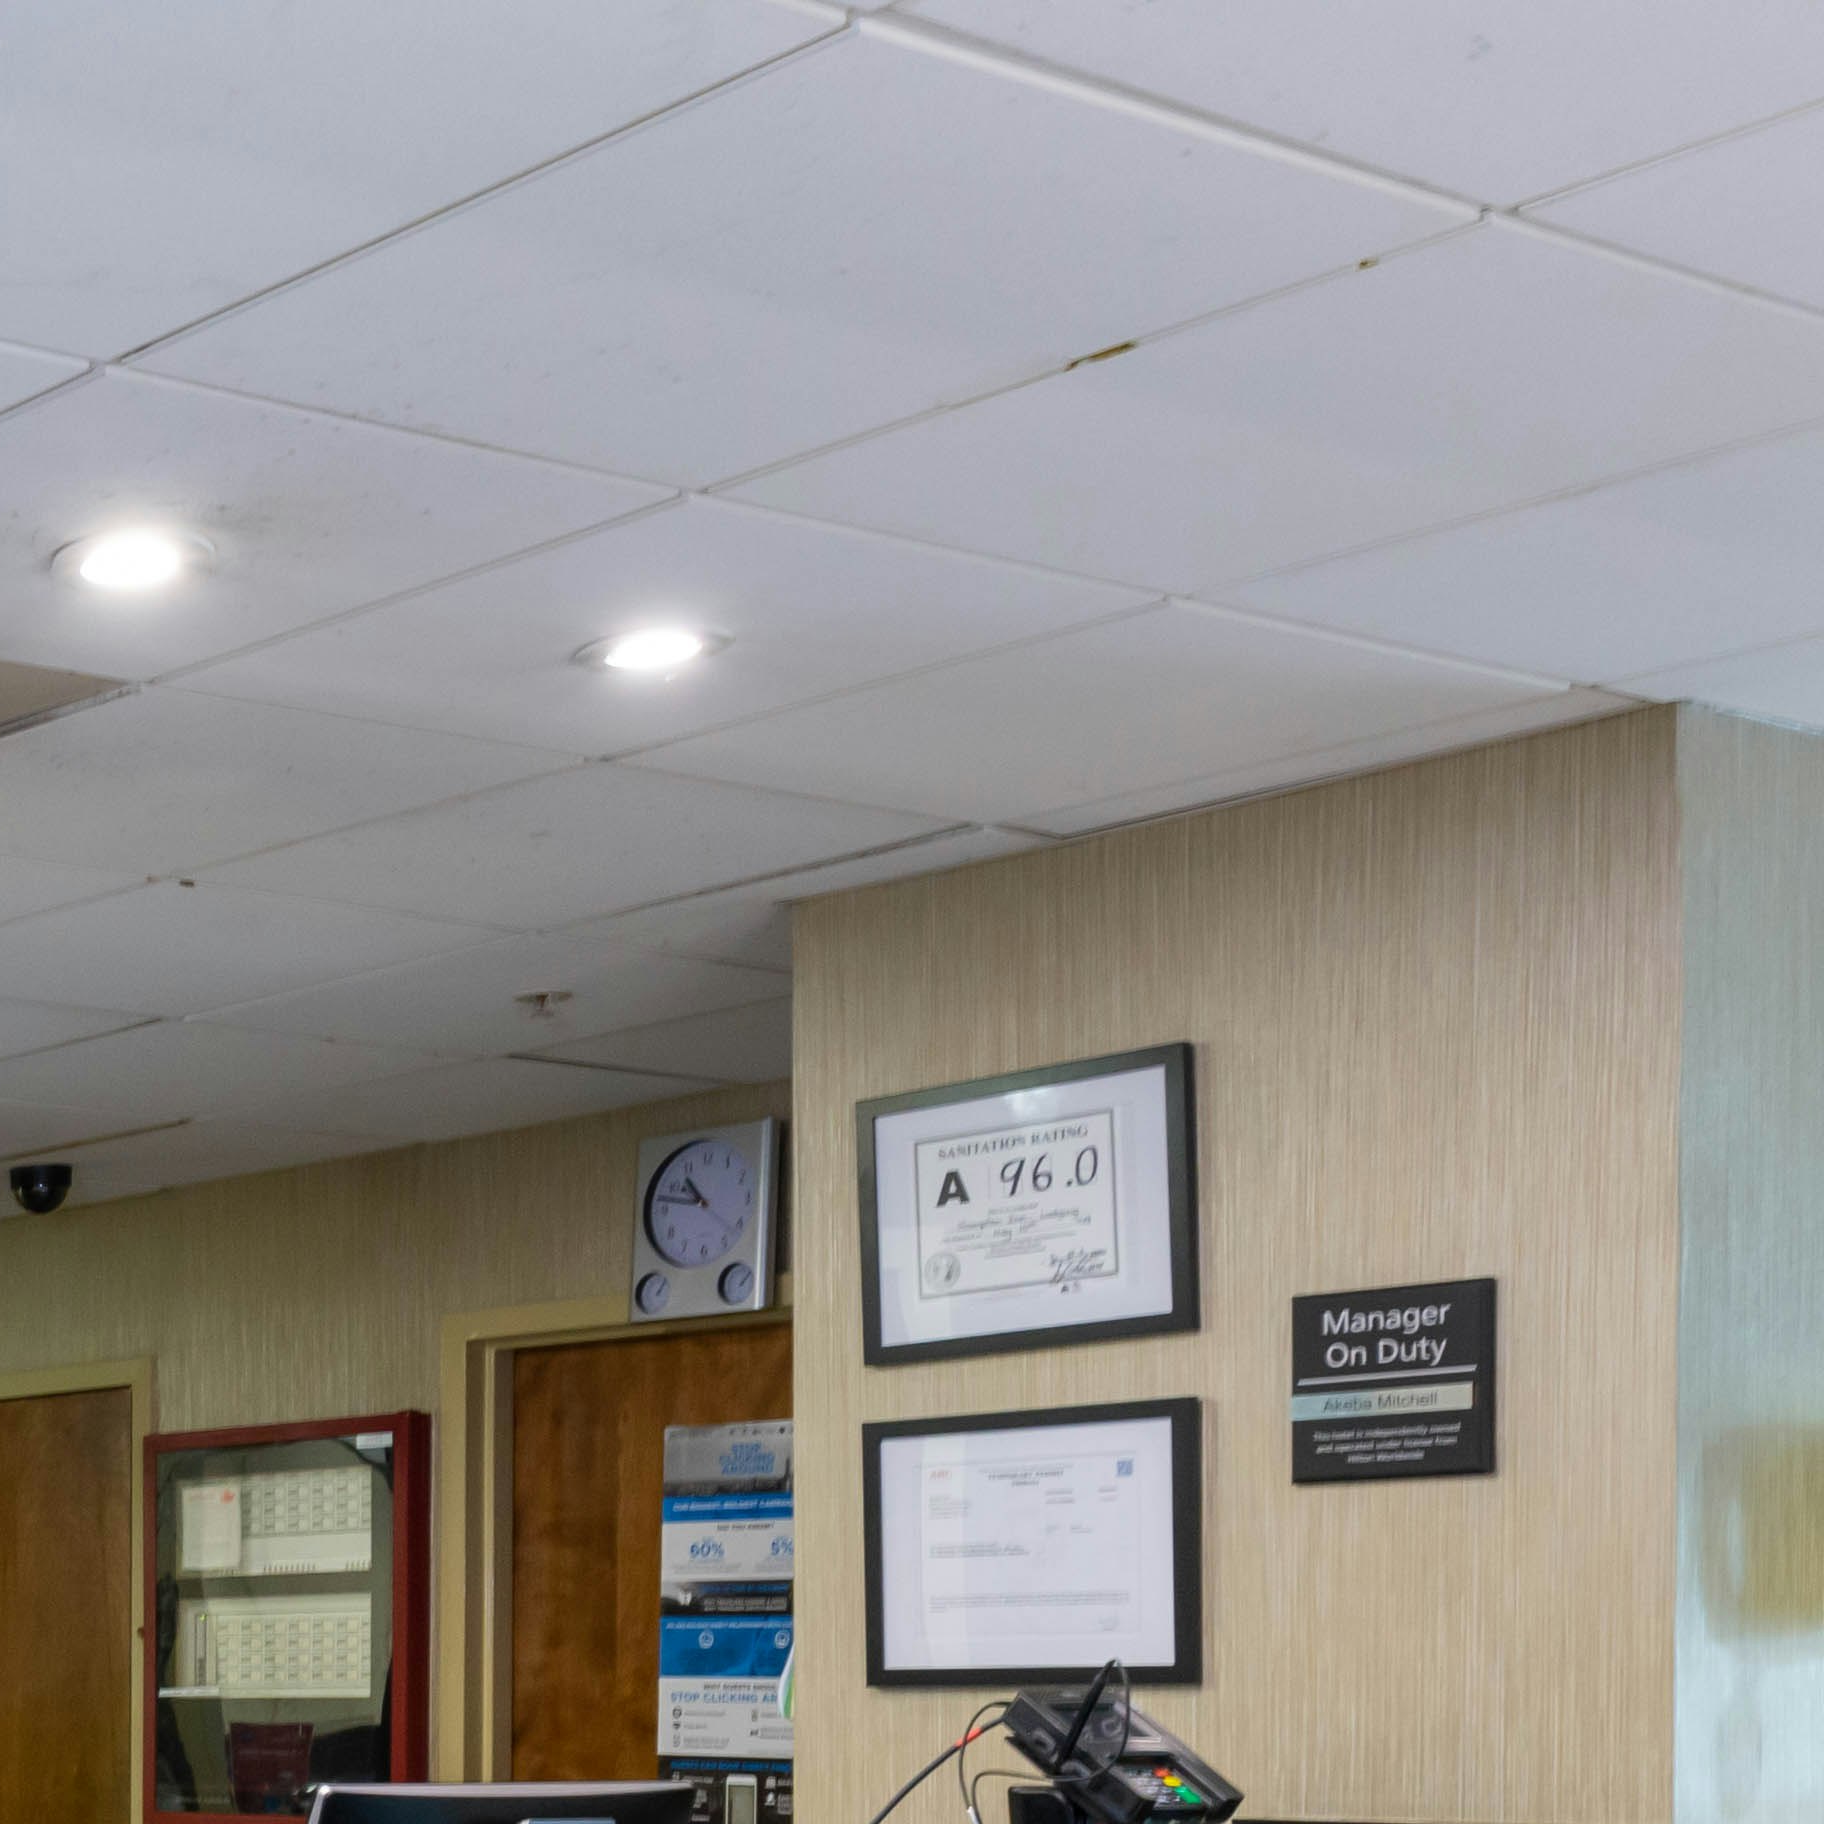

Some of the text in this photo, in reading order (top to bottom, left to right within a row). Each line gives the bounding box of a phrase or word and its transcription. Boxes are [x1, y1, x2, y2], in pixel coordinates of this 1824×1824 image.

[938, 1125, 1089, 1160] SANITATION RATING
[1000, 1144, 1099, 1197] 96.0
[936, 1169, 970, 1208] A
[1321, 1303, 1451, 1336] Manager
[1324, 1336, 1448, 1368] On Duty
[1377, 1392, 1438, 1410] Mitchell
[670, 1691, 700, 1702] STOP
[703, 1692, 758, 1704] CLICKING
